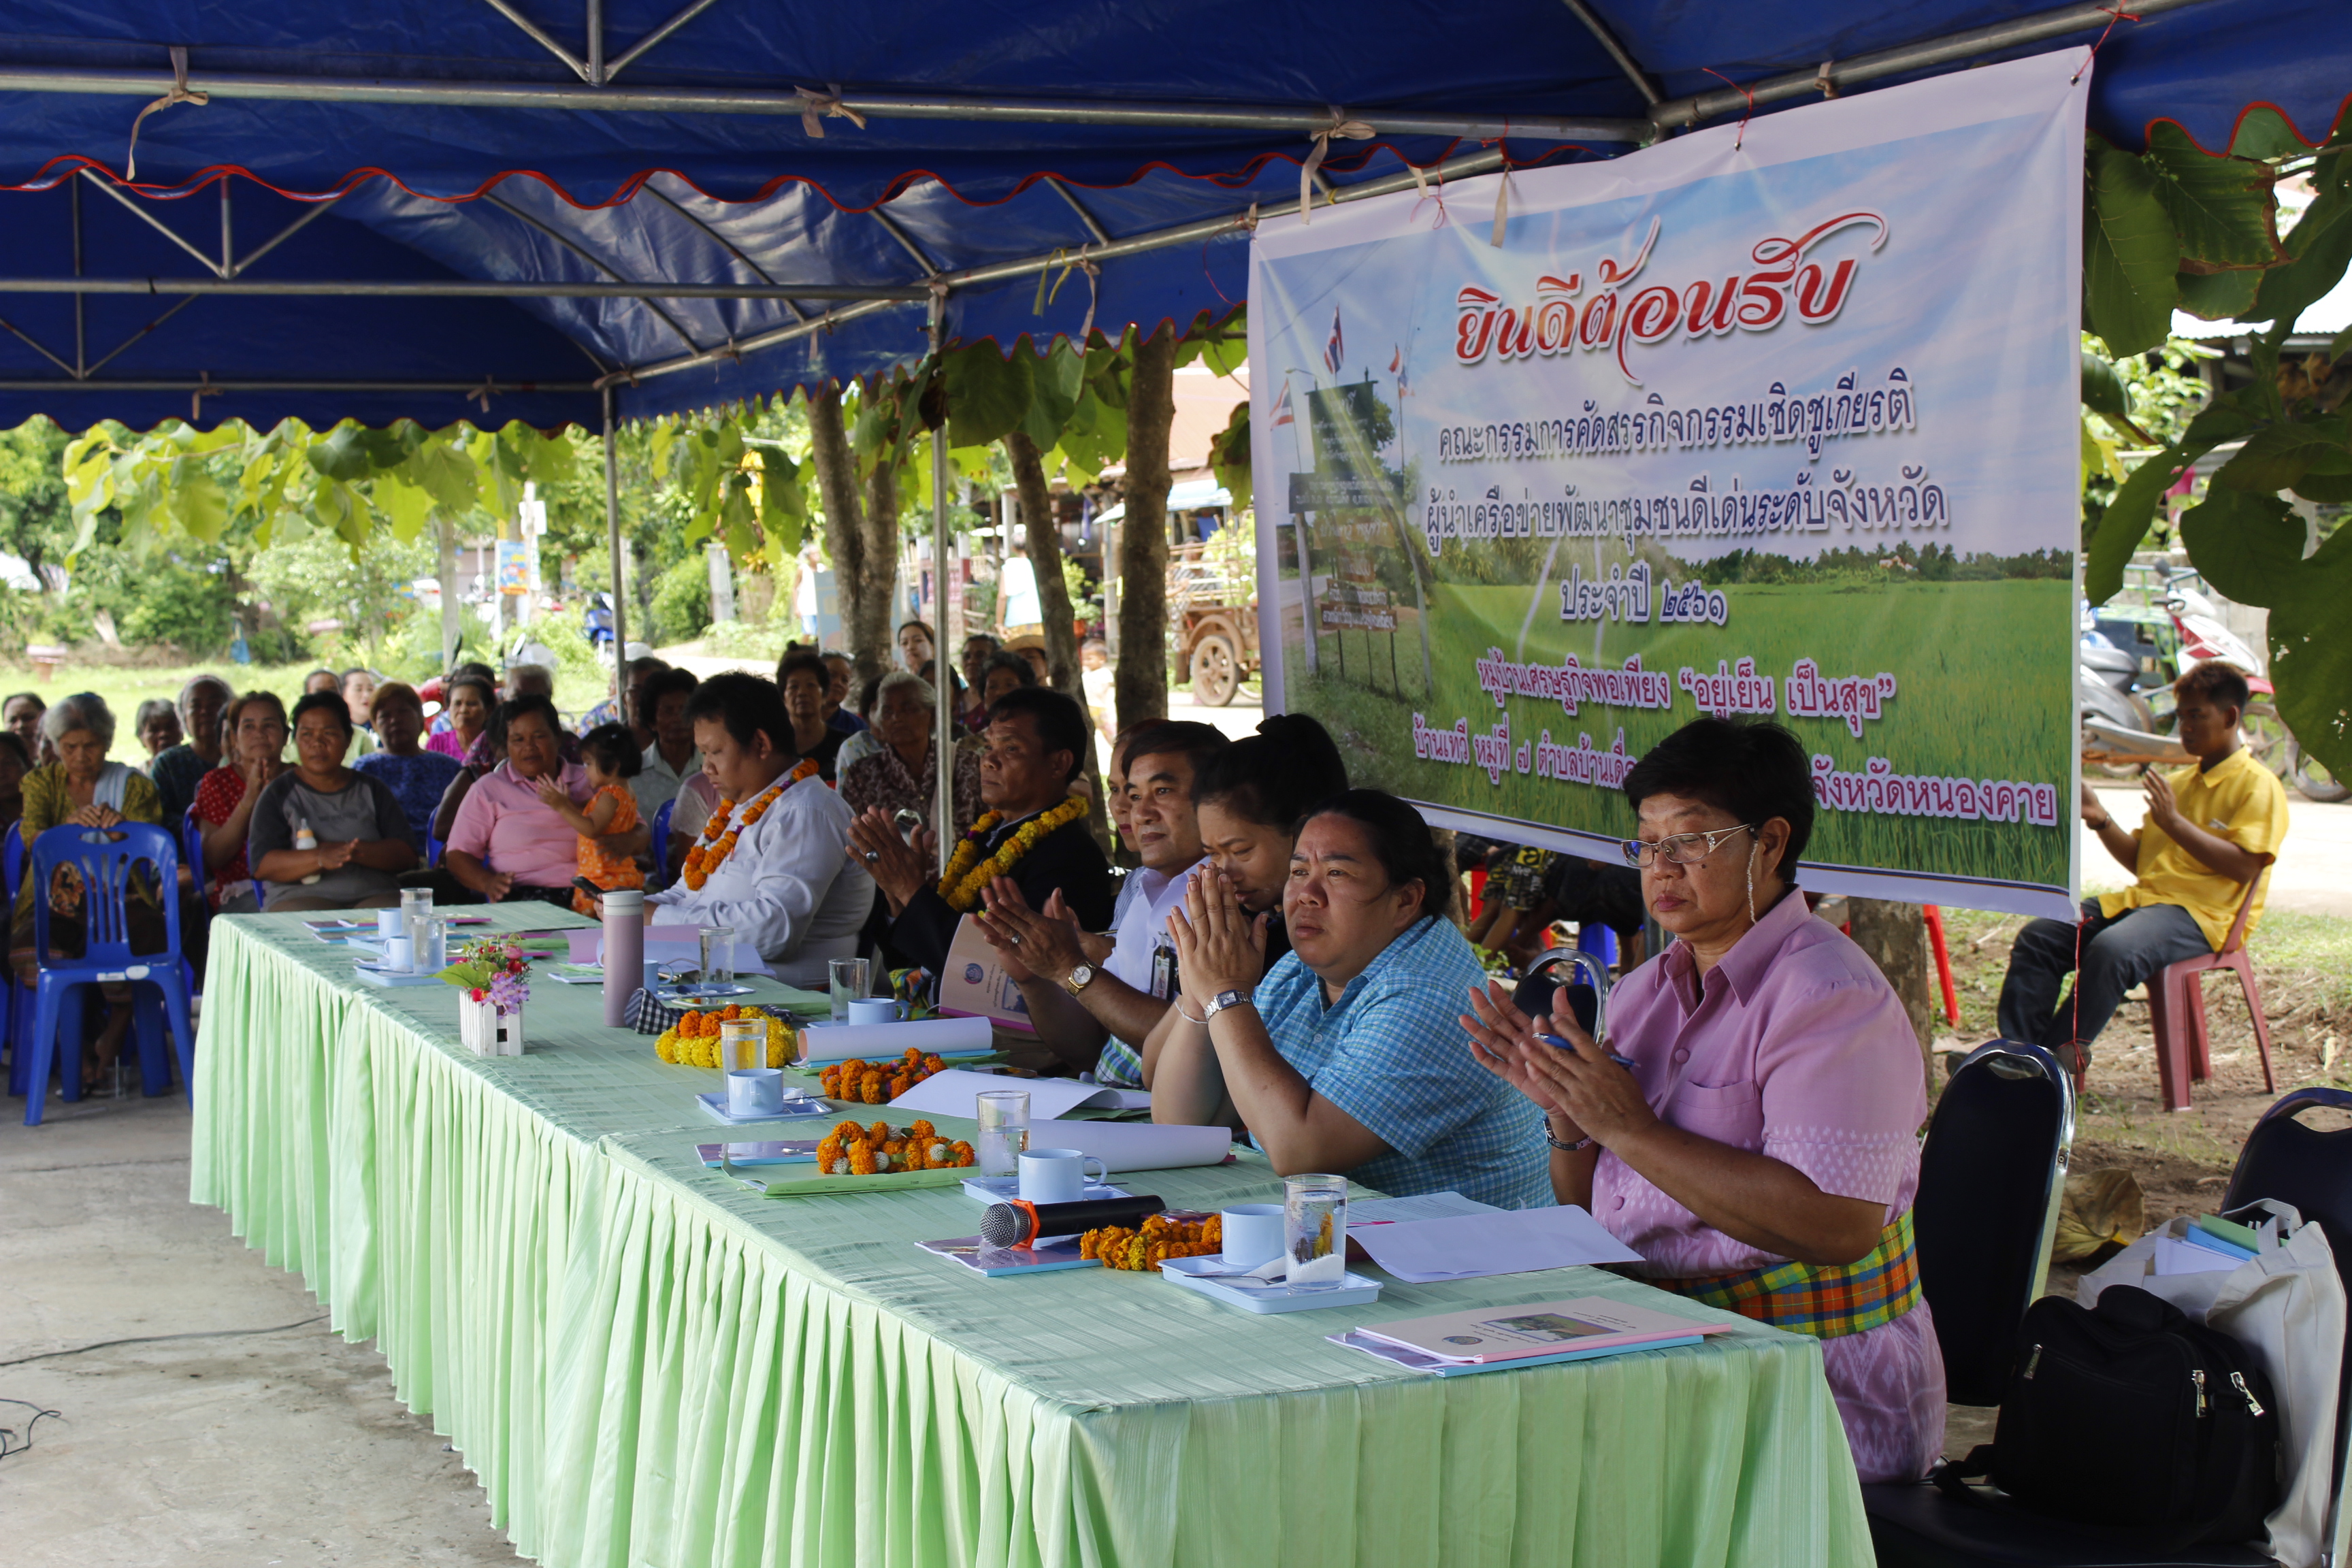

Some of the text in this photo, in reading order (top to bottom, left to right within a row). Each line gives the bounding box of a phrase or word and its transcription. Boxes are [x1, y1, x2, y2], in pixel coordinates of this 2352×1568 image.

[1457, 212, 1886, 382] ยินดีต้อนรับ
[1439, 367, 1910, 453] คณะกรรมการคัดสรรกิจกรรมเชิดชูเกียรติ
[1426, 465, 1945, 553] ผู้นำเครือข่ายพัฒนาชุมชนดีเด่นระดับจังหวัด
[1561, 564, 1725, 620] ประจำปี ๒๕๖๑
[1477, 649, 1668, 712] หมู่บ้านเศรษฐกิจพอเพียง
[1787, 662, 1893, 732] เป็นสุข”
[1414, 716, 1469, 762] บ้านเทวี
[1475, 716, 1509, 781] หมู่ที่
[1518, 742, 1529, 770] ๗
[1811, 758, 2055, 821] จังหวัดหนองคาย
